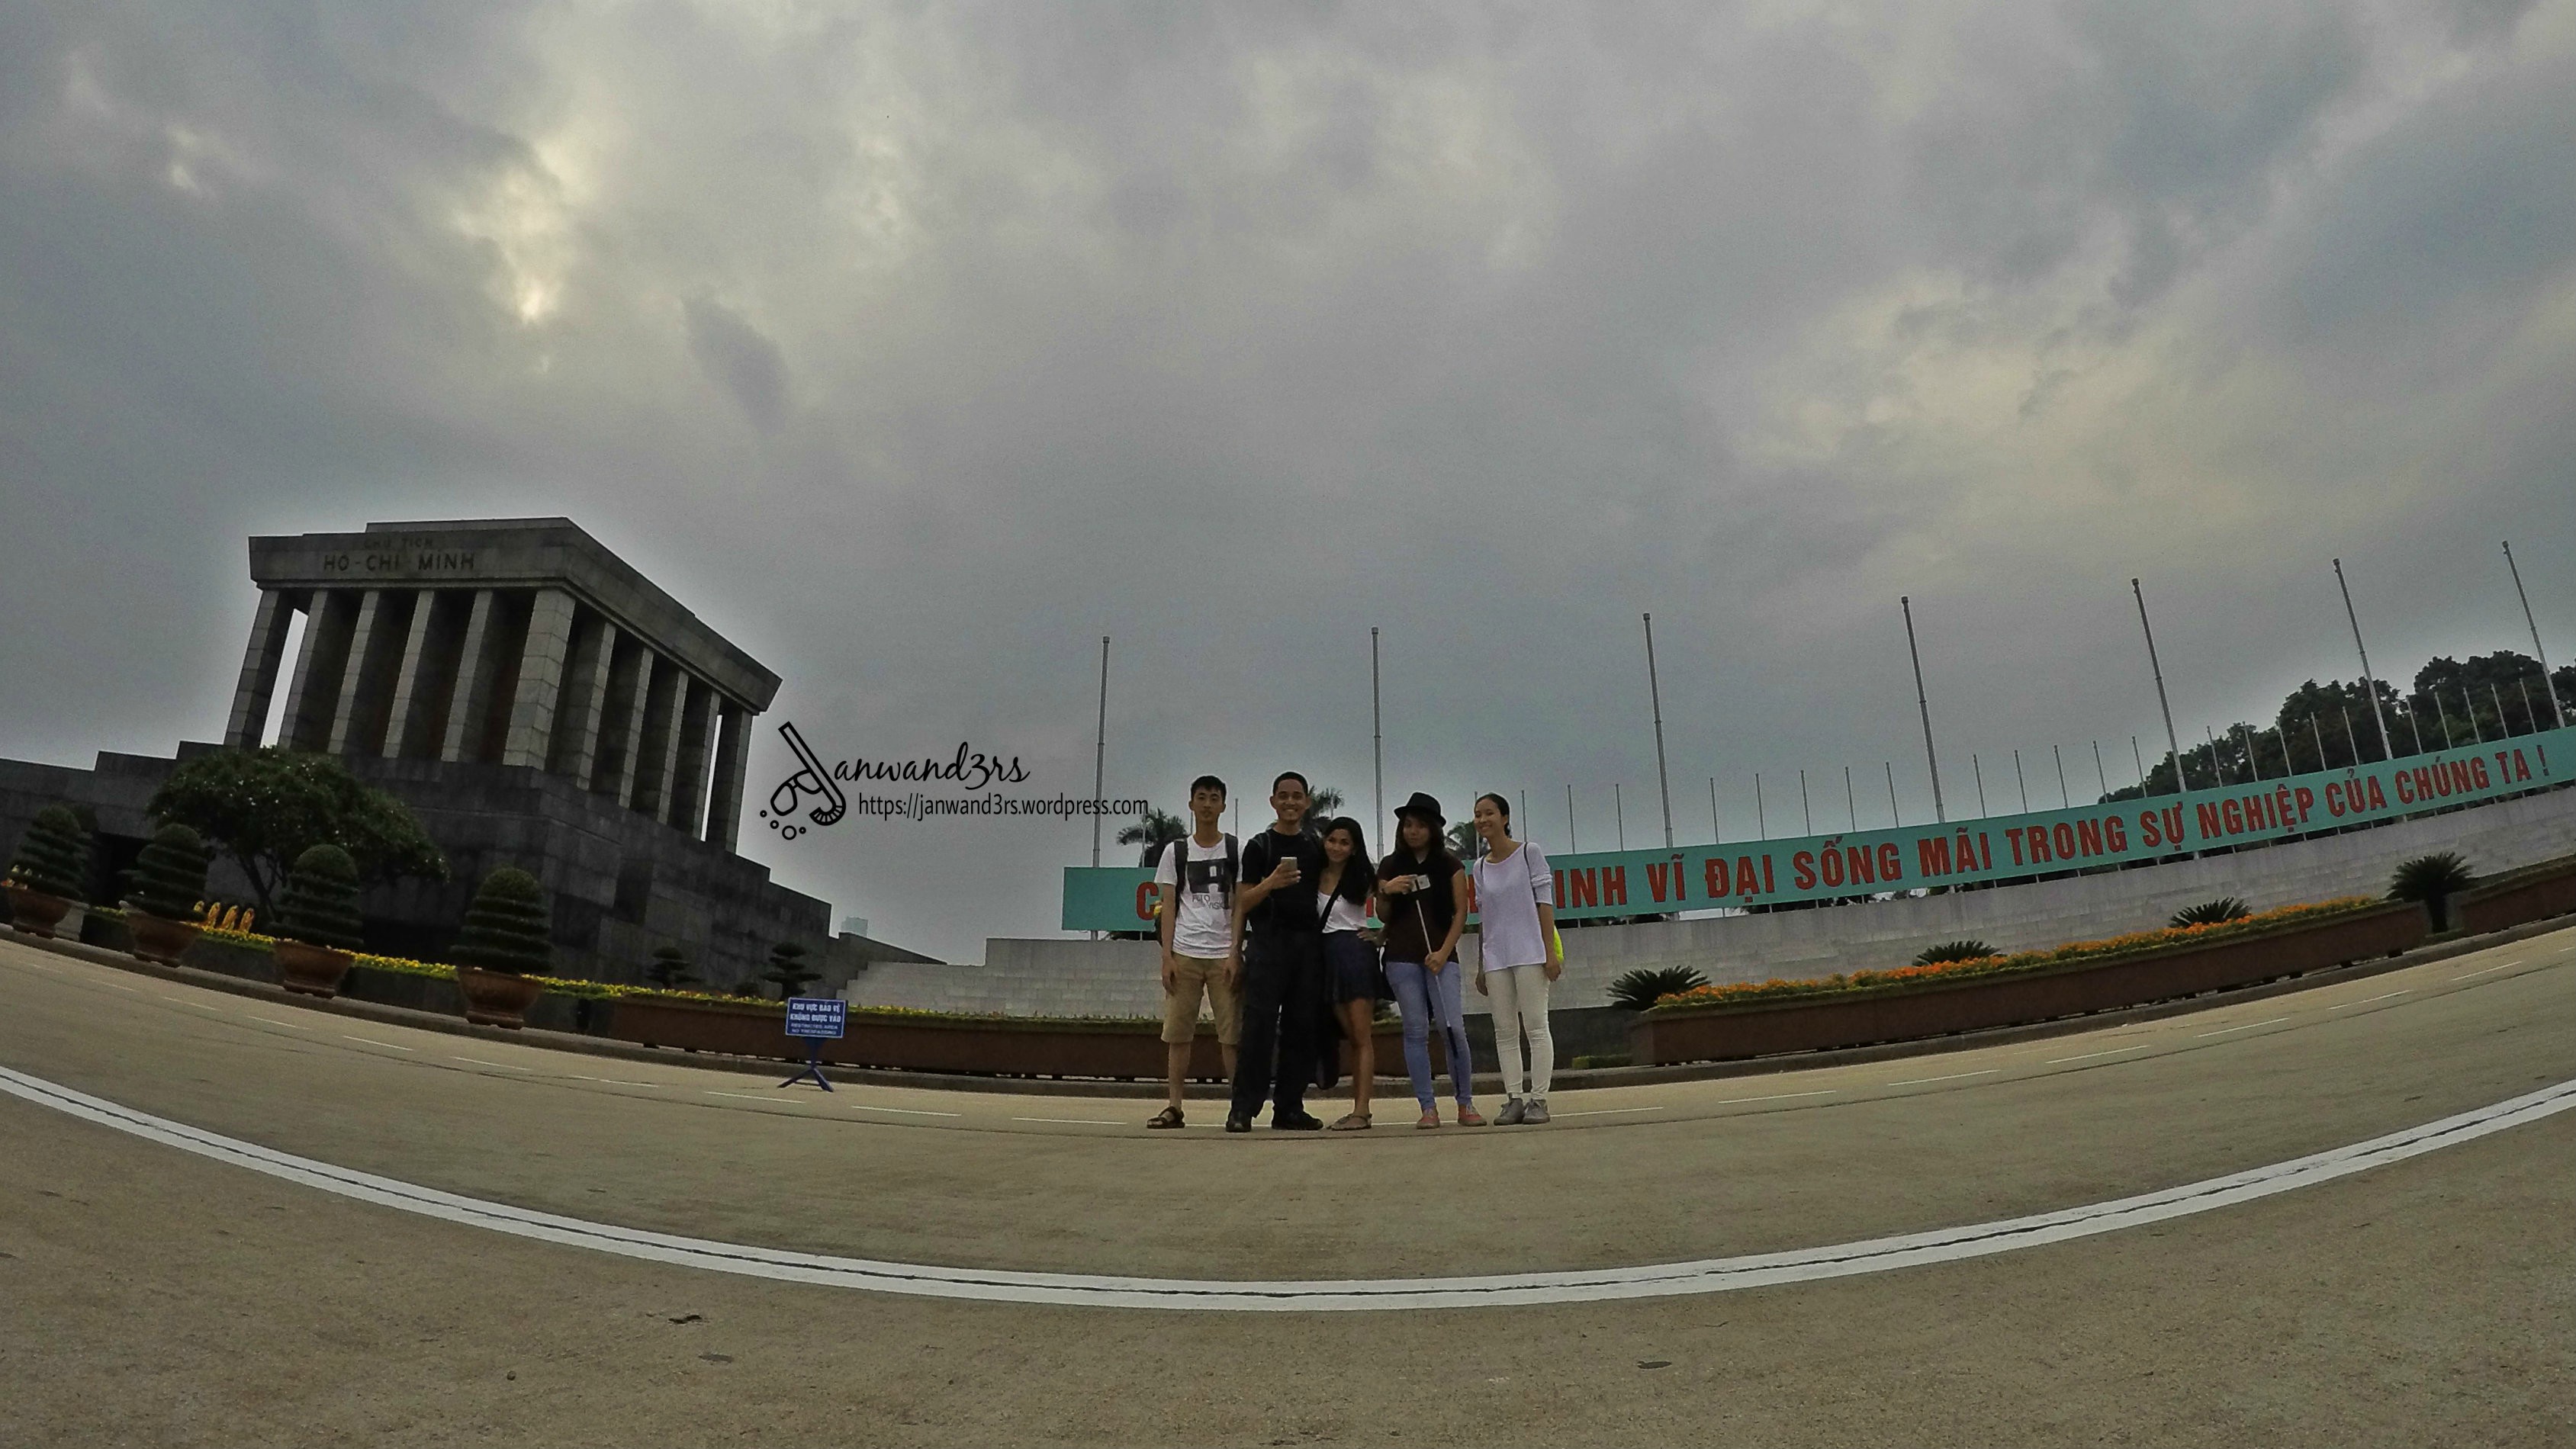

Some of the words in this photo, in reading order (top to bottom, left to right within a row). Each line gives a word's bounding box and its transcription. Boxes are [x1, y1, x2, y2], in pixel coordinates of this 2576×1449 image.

[1554, 865, 1628, 909] INH
[1646, 853, 1687, 904] VĨ
[1704, 854, 1775, 903] ĐẠI
[1793, 835, 1903, 891] SỐNG
[1918, 826, 1993, 878] MÃI
[2005, 815, 2128, 866] TRONG
[2140, 801, 2185, 851] SỰ
[2196, 783, 2315, 840] NGHIỆP
[2324, 767, 2388, 818] CỦA
[2394, 756, 2491, 805] CHÚNG
